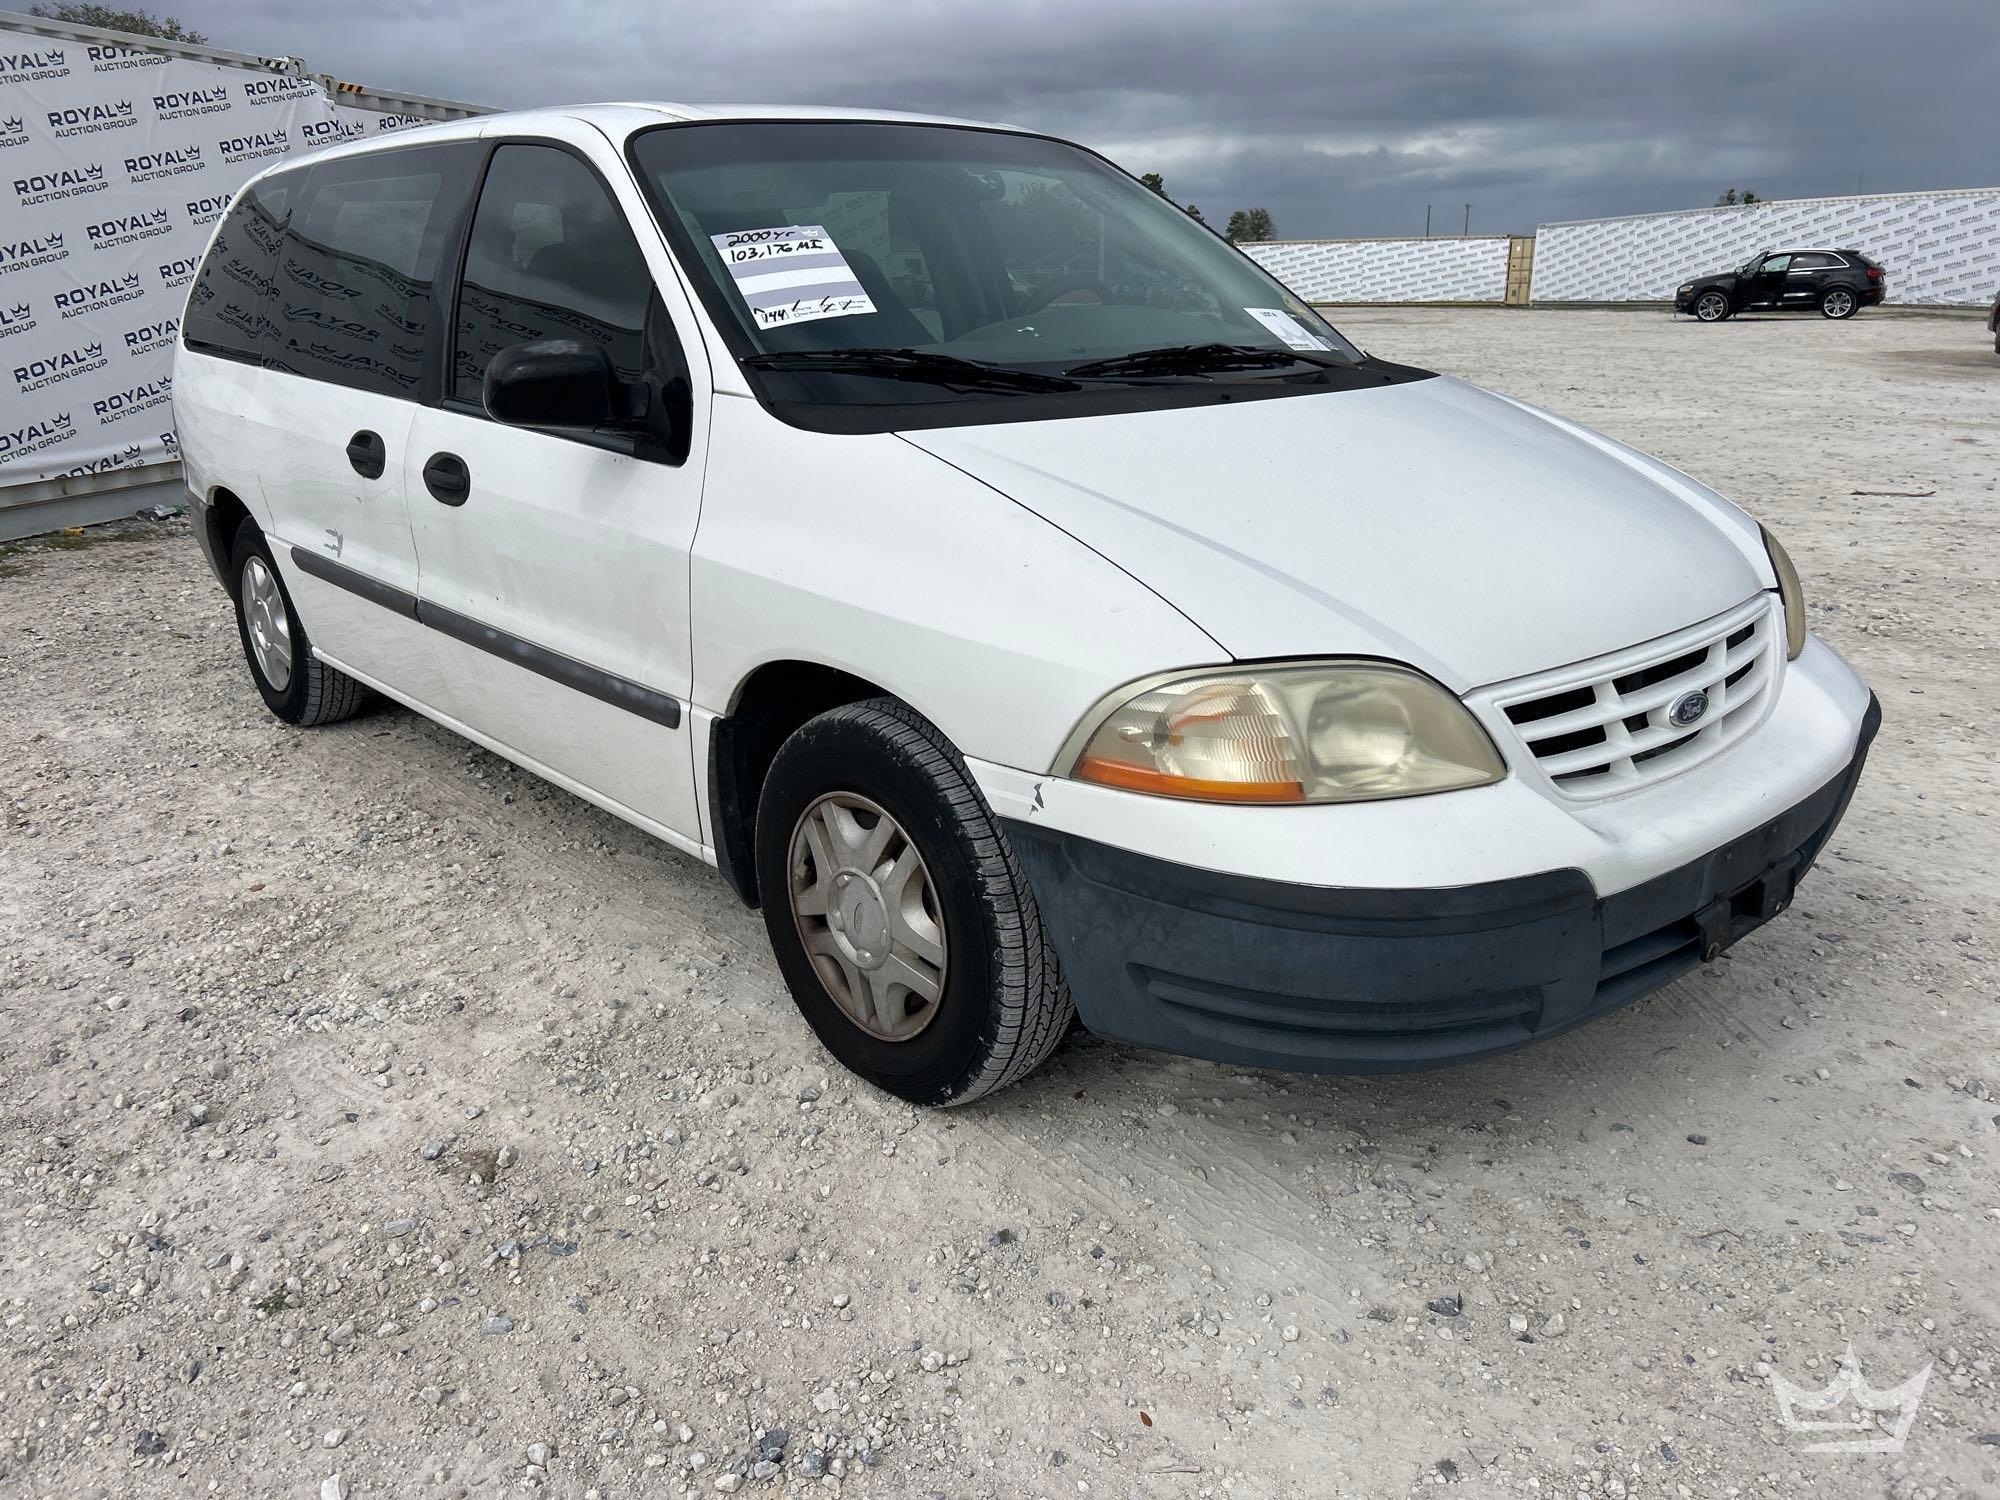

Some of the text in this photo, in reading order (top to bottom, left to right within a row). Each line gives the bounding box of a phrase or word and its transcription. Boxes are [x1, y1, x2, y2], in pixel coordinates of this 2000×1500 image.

[87, 46, 149, 61] ROYA
[94, 56, 173, 73] AUCTION GROUP
[31, 68, 71, 81] GROUP
[244, 78, 298, 97] ROYAL
[250, 88, 317, 107] AUCTION GROUP
[152, 89, 214, 111] ROYAL
[47, 104, 117, 127] ROYAL
[159, 102, 232, 121] AUCTION GROUP
[55, 118, 138, 139] AUCTION GROUP
[0, 136, 30, 148] ROUP
[220, 133, 274, 155] ROYAL
[307, 134, 343, 147] AUCTIO
[124, 150, 187, 173] ROYAL
[224, 144, 291, 165] AUCTION GROUP
[14, 169, 88, 196] ROYAL
[131, 162, 205, 184] AUCTION GROUP
[21, 182, 109, 207] AUCTION GROUP
[186, 193, 234, 216] ROYA
[86, 214, 154, 240] ROYAL
[94, 225, 173, 251] AUCTION GROUP
[726, 230, 772, 248] 2000
[730, 240, 824, 263] 103,176 MI
[0, 250, 70, 276] TION GROUP
[159, 256, 202, 279] ROY
[165, 274, 195, 289] AUCTI
[54, 280, 125, 309] ROYAL
[61, 290, 145, 320] AUCTION GROUP
[0, 320, 37, 339] GROUP
[130, 337, 173, 357] AUCTION
[13, 350, 87, 384] ROYAL
[20, 358, 108, 395] AUCTION GROUP
[93, 383, 160, 416] ROYAL
[100, 393, 172, 427] AUCTION GROU
[38, 429, 77, 449] GROUP
[54, 453, 124, 480] OYAL
